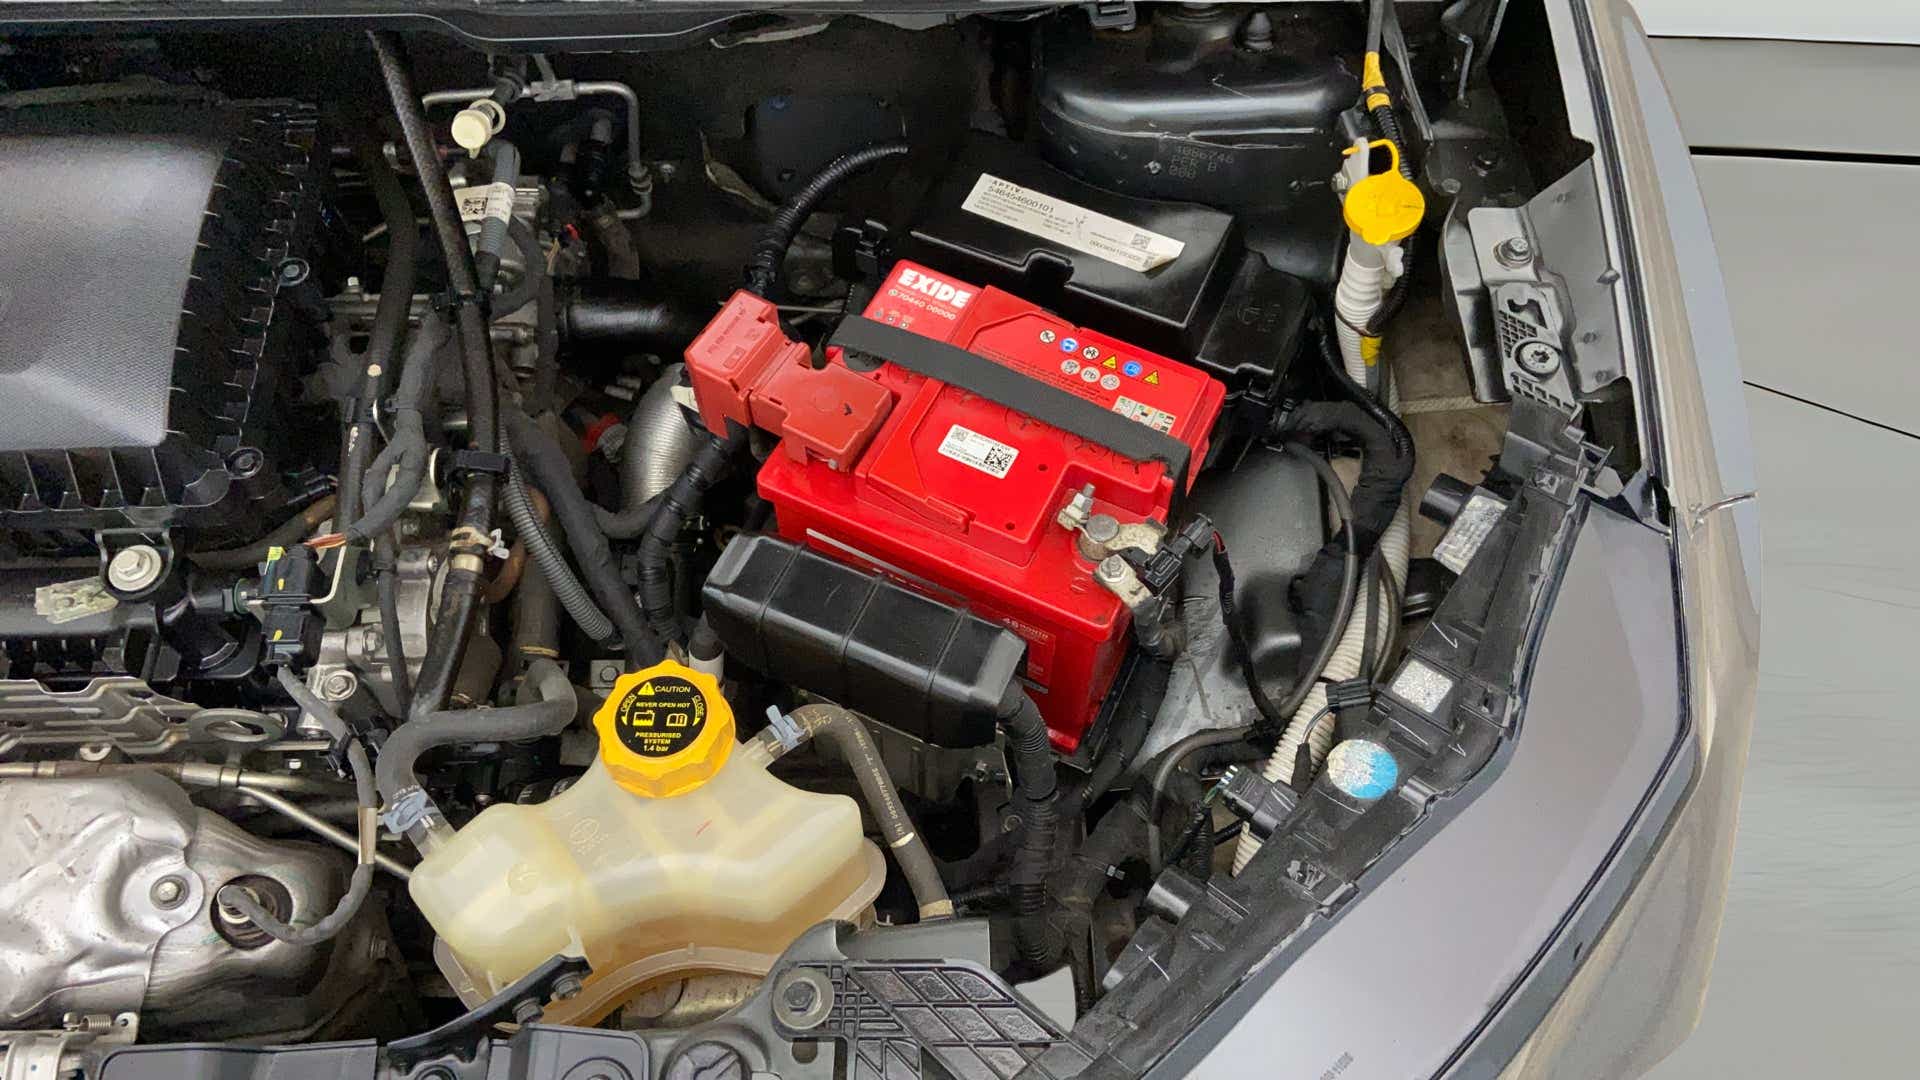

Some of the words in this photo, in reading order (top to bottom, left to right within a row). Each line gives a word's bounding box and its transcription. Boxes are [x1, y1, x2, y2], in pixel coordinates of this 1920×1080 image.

[897, 267, 972, 309] EXIDE
[654, 685, 691, 693] CAUTION
[621, 693, 637, 712] OPEN
